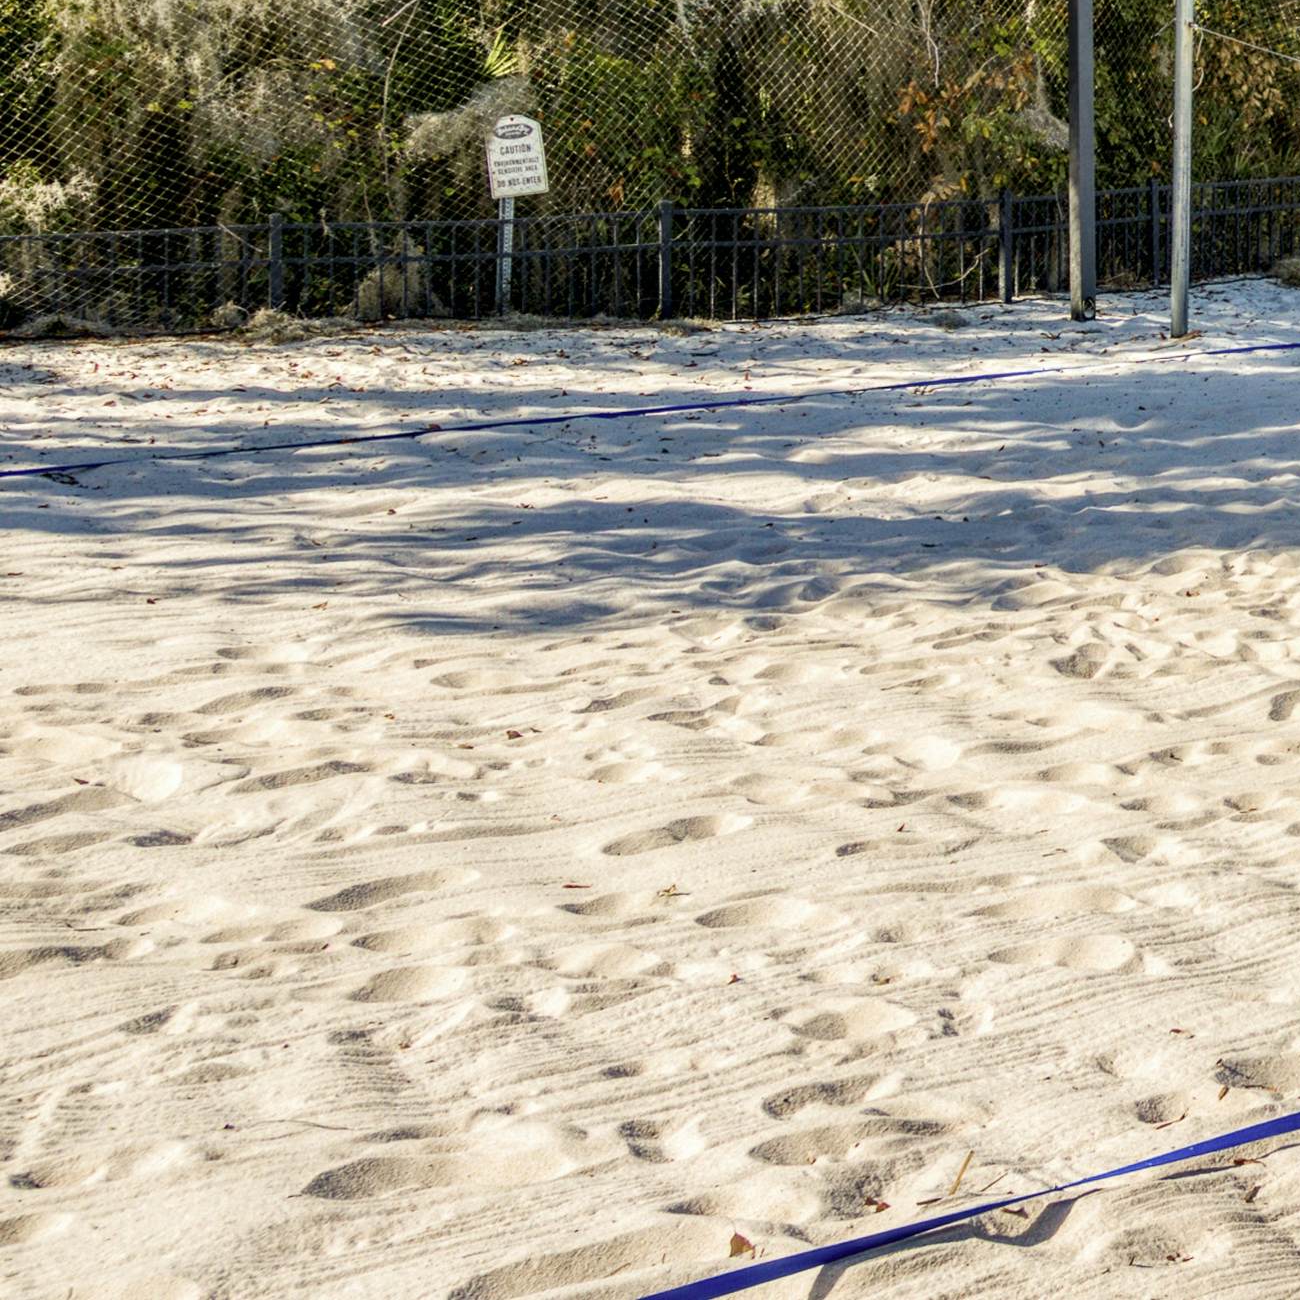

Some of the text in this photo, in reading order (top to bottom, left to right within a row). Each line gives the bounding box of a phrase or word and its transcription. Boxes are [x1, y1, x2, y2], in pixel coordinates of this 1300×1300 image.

[500, 143, 531, 156] CAUTION
[508, 177, 520, 187] NOT
[522, 175, 541, 185] ENTER
